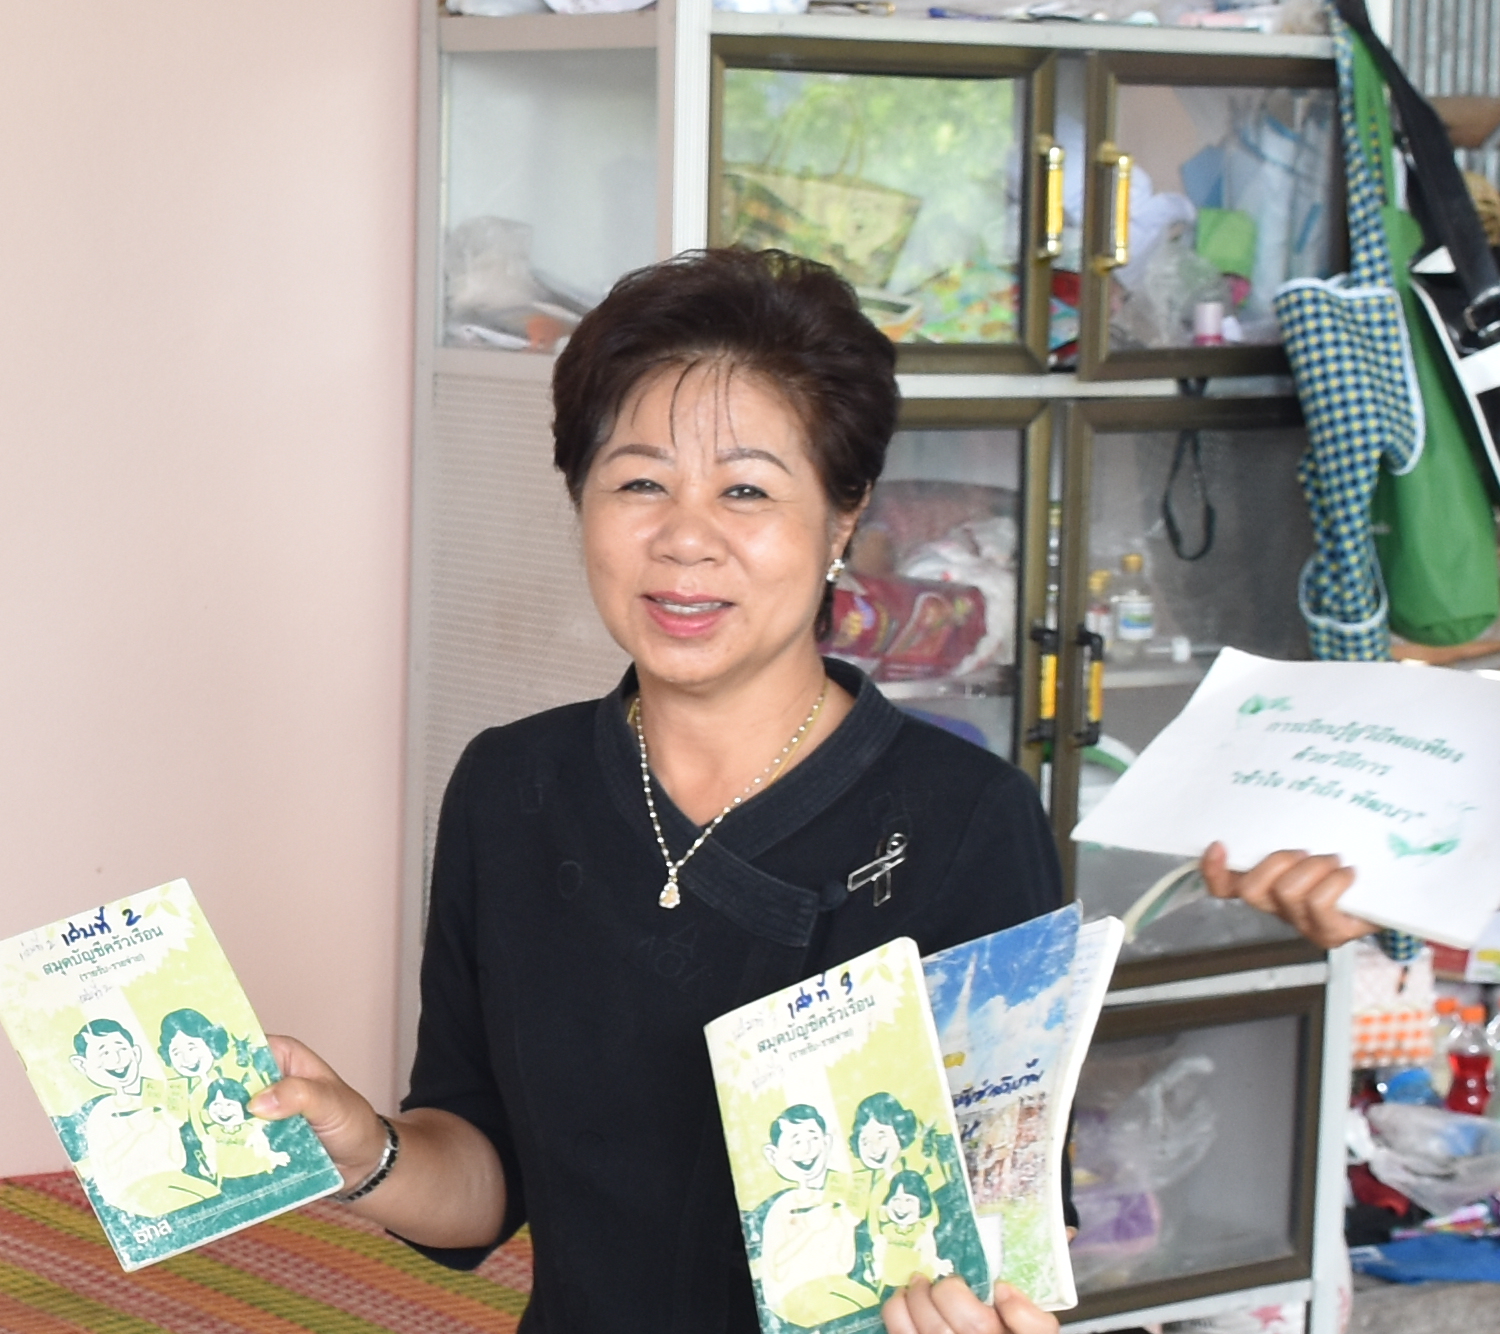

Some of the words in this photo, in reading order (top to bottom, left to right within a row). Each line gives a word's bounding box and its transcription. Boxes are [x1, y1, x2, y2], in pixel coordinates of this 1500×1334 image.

[121, 908, 142, 926] 2
[42, 925, 164, 976] สมุดบัญชีครัวเรือน
[757, 994, 876, 1055] สมุดบัญชีครัวเรือน
